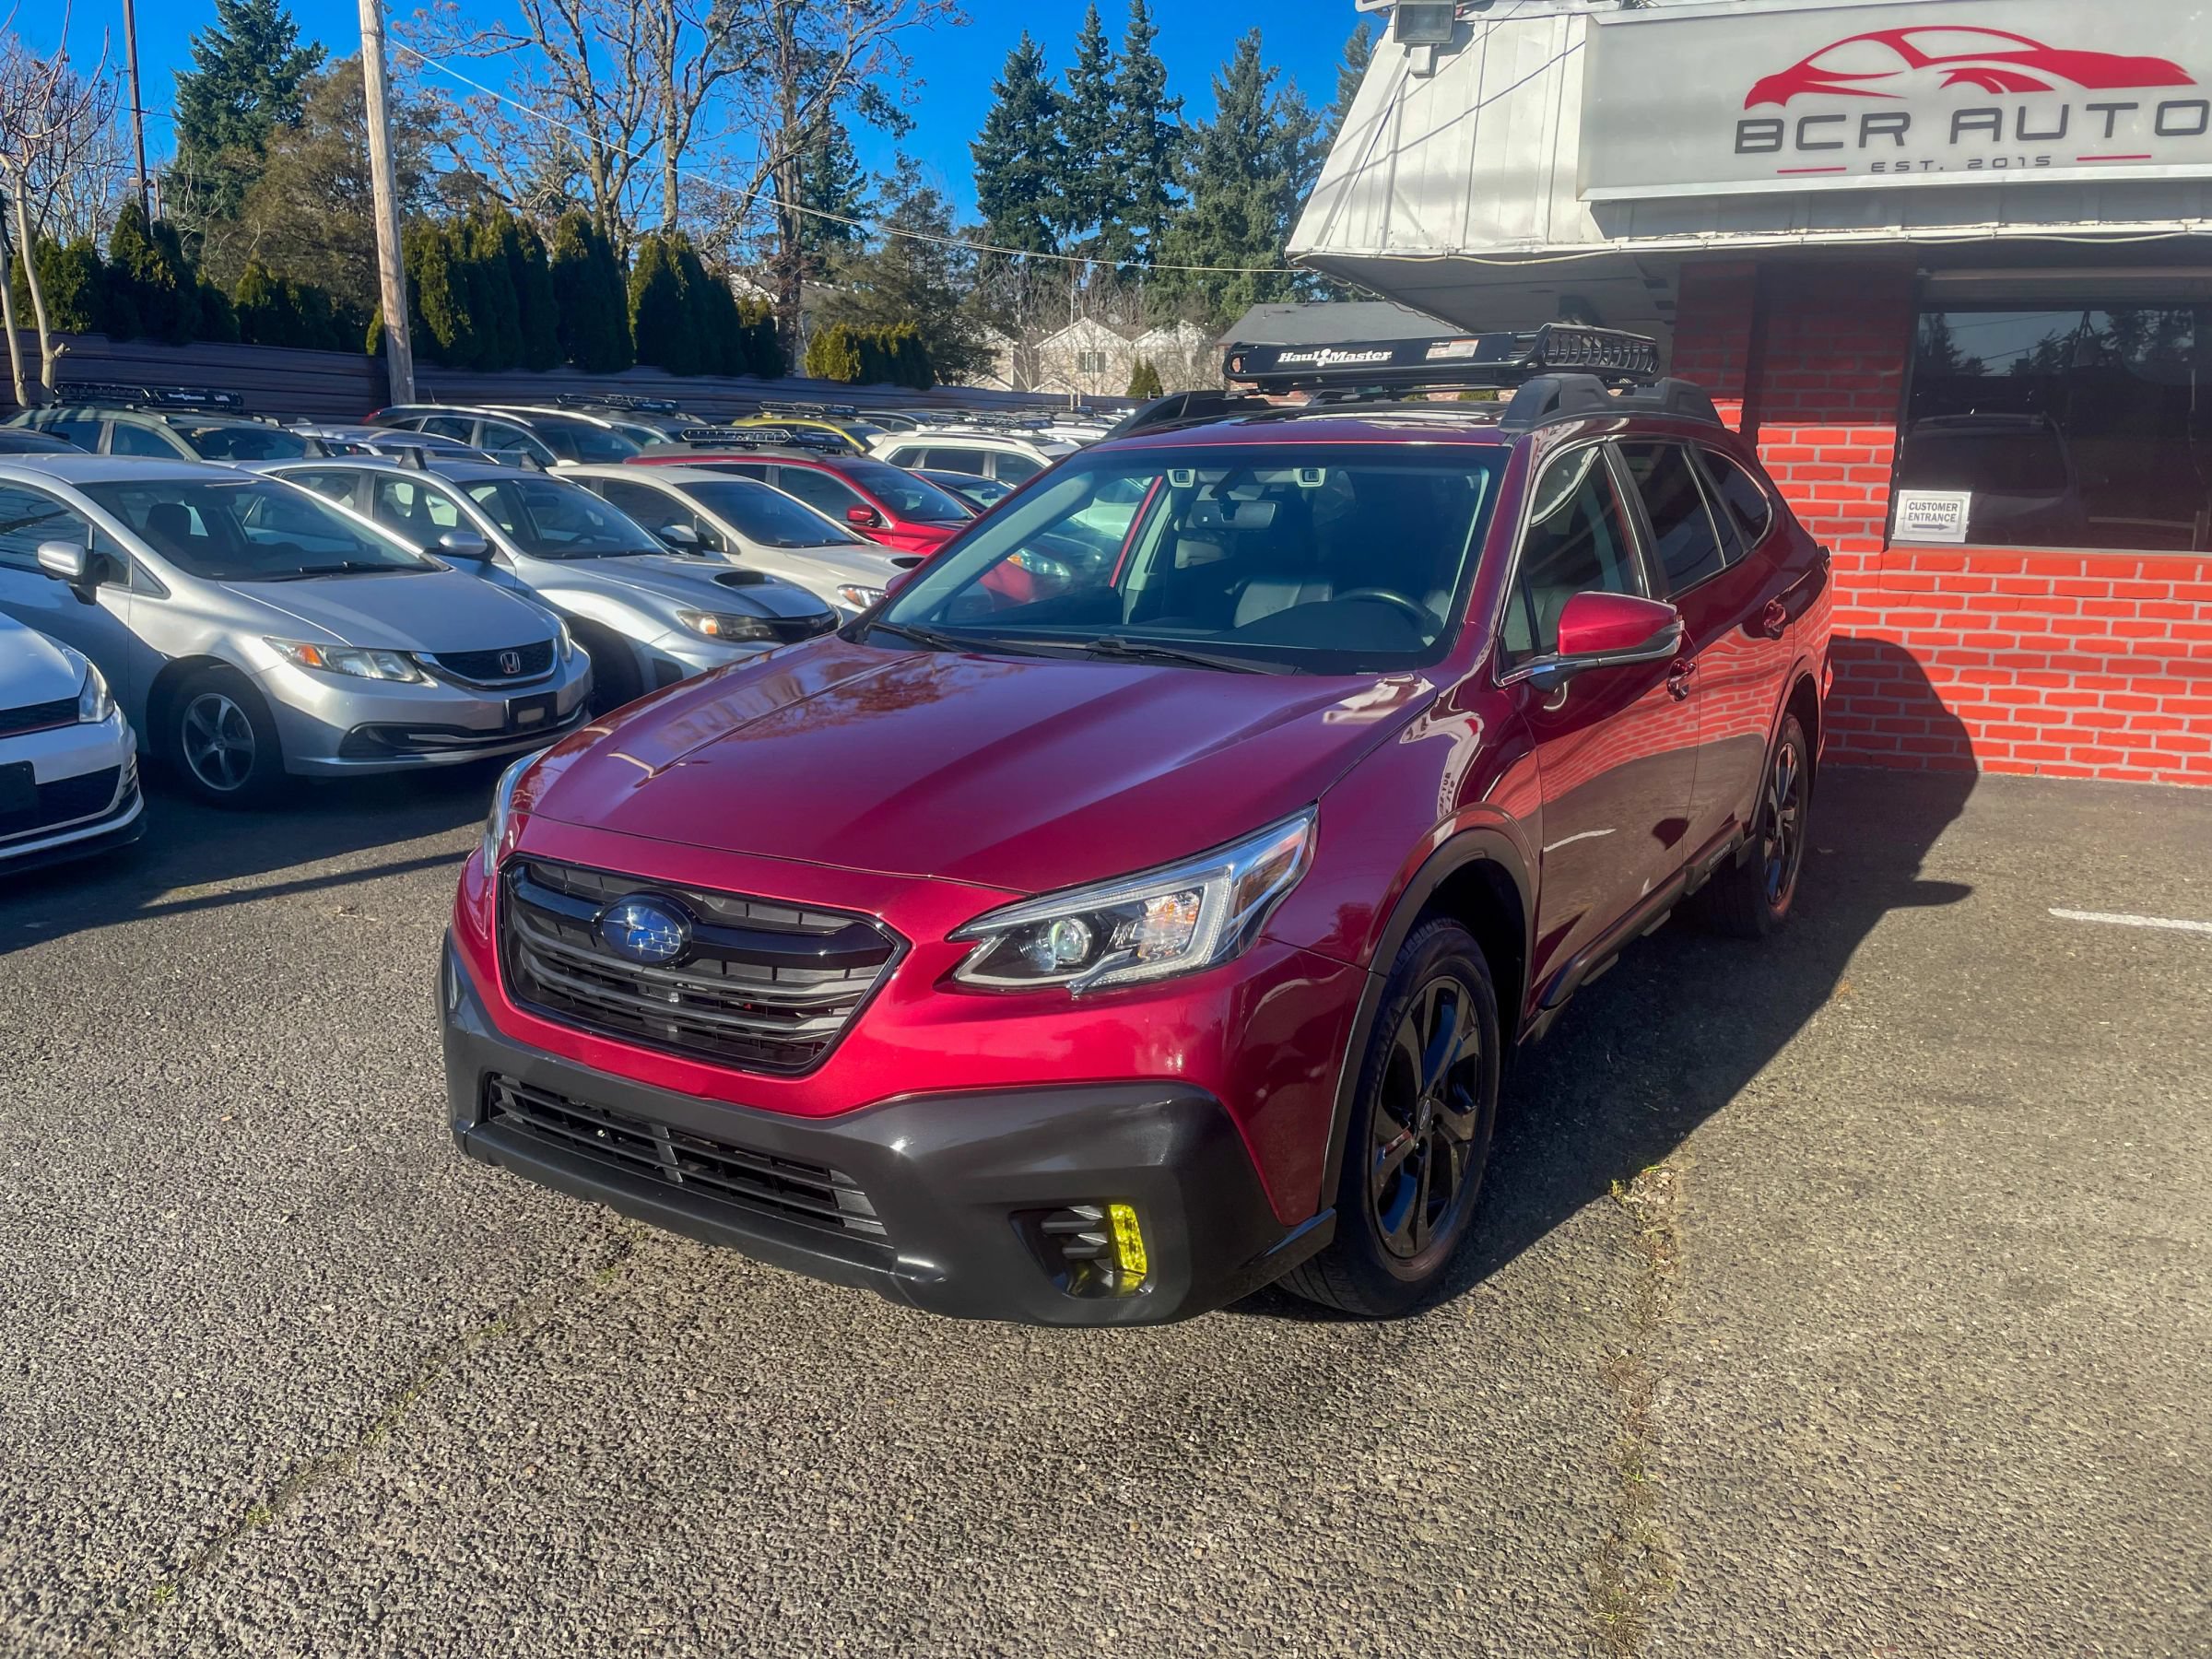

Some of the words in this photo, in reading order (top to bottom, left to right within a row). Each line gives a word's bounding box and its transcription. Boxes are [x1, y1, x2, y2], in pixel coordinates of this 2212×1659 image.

[1735, 112, 1912, 154] BCR
[1949, 99, 2210, 145] AUTO
[1870, 159, 1944, 173] EST.
[1967, 155, 2052, 171] 2015
[1325, 350, 1393, 364] Master
[1909, 501, 1959, 512] CUSTOMER
[1908, 512, 1957, 523] ENTRANCE
